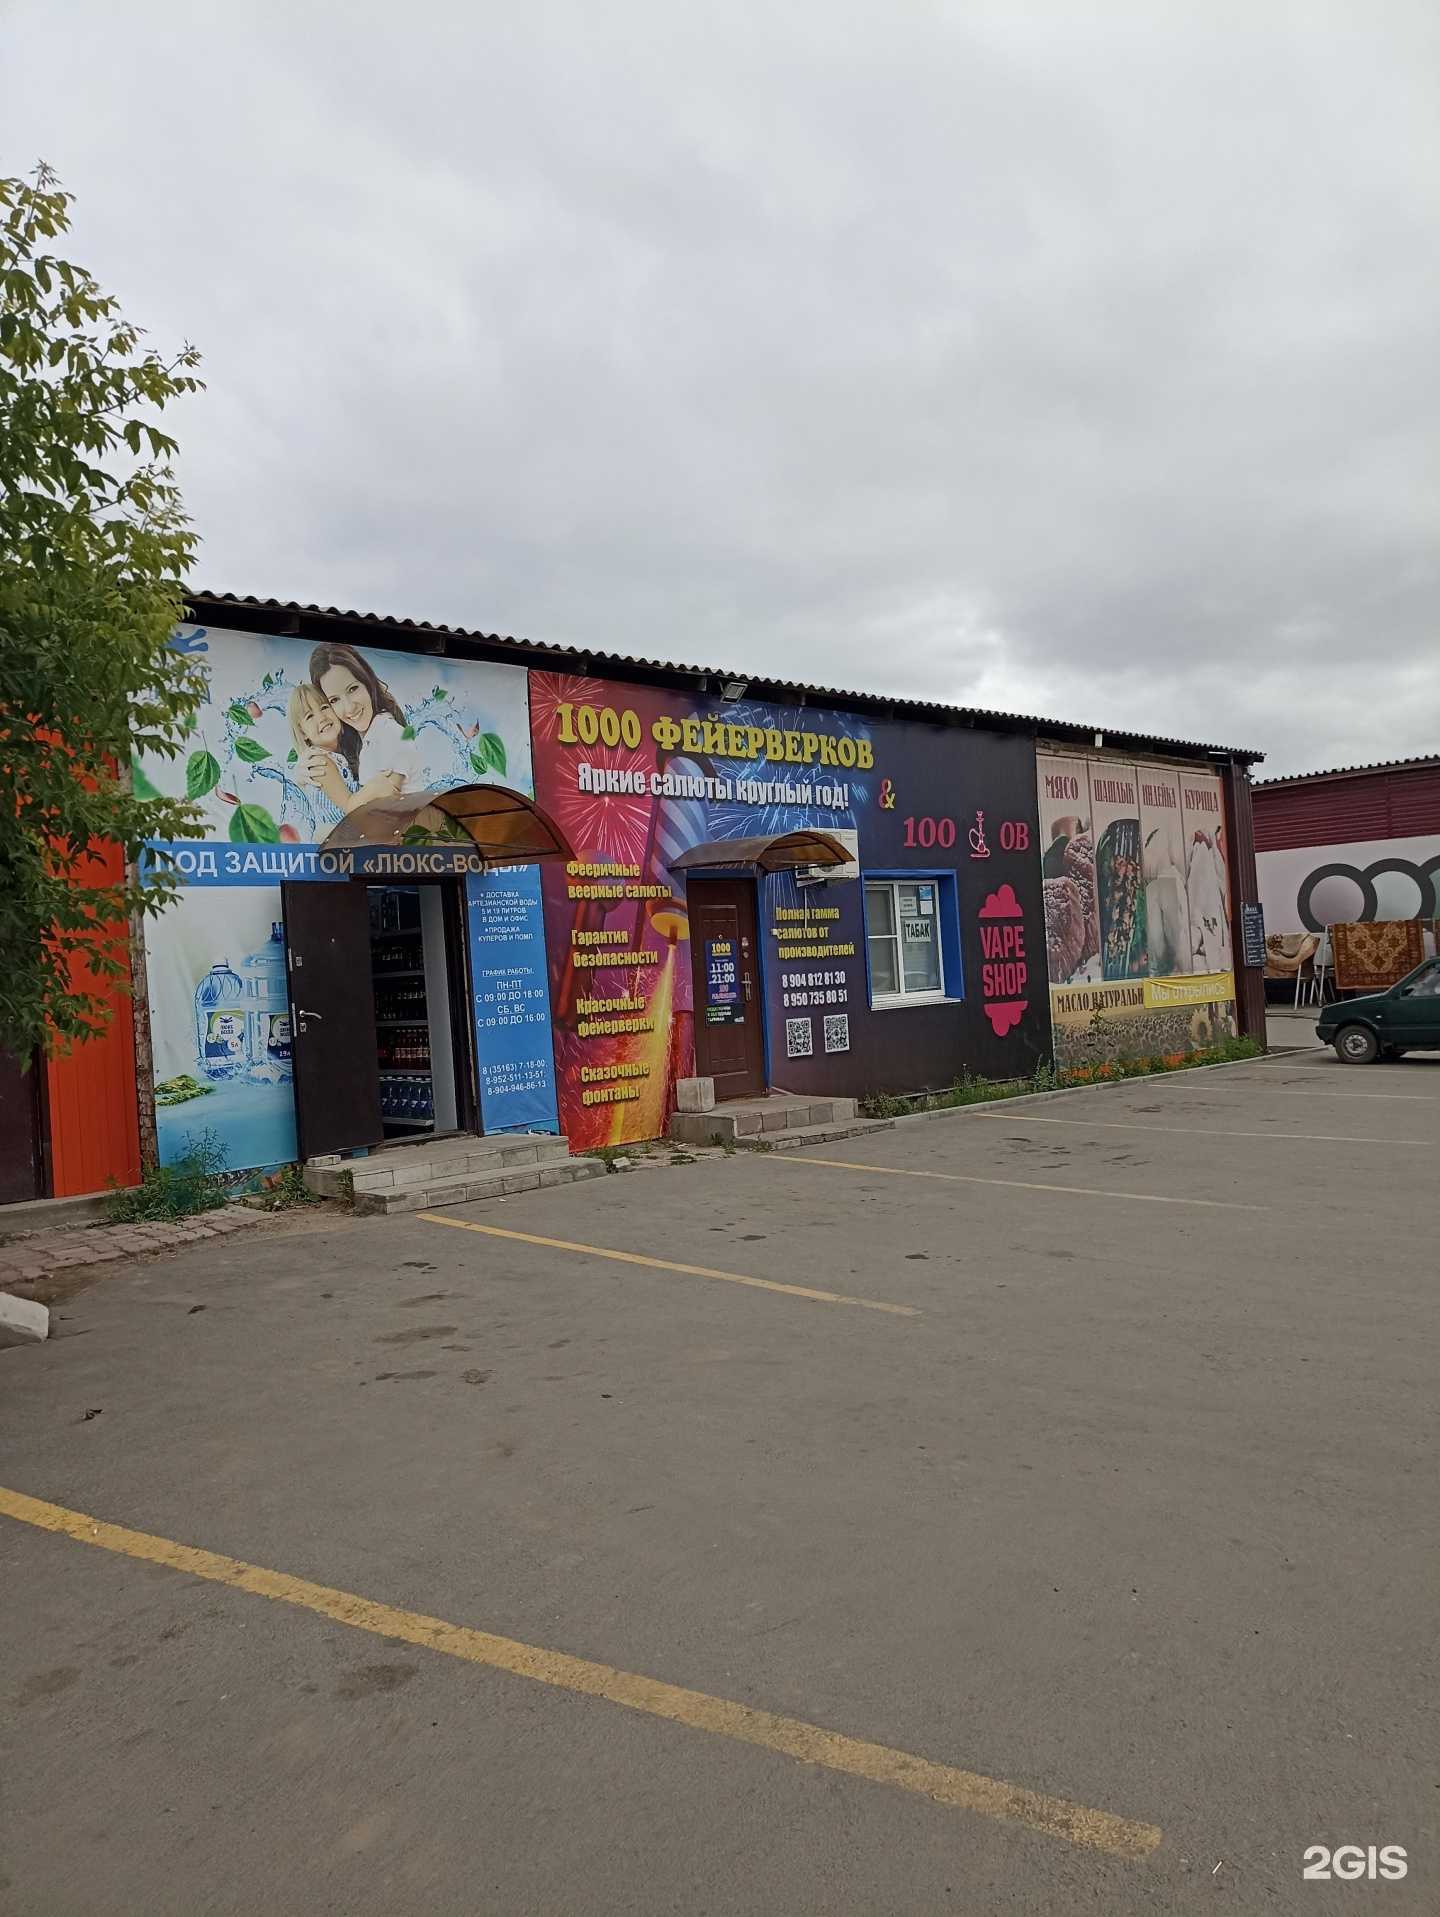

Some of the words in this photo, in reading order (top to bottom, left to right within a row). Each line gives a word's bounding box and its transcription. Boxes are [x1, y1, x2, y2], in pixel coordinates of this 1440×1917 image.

[556, 703, 642, 749] 1000
[651, 712, 875, 769] ФЕЙЕРВЕРКОВ
[577, 762, 646, 794] Яркие
[650, 771, 733, 800] салюты
[736, 778, 813, 805] круглый
[815, 783, 849, 810] год!
[878, 778, 896, 809] &
[1045, 775, 1079, 801] МЯСО
[1093, 778, 1135, 805] ШАШЛЫК
[1142, 783, 1177, 809] ИНДЕЙКА
[1184, 788, 1219, 813] КУРИЦА
[903, 816, 956, 848] 100
[1000, 821, 1029, 851] ОВ
[224, 847, 354, 877] ЗАЩИТОЙ
[566, 860, 641, 878] Фееричные
[486, 891, 520, 899] ДОСТАВКА
[567, 884, 624, 899] веерные
[625, 884, 673, 898] салюты
[520, 898, 538, 906] ВОДЫ
[775, 906, 811, 920] Полная
[811, 907, 840, 920] гамма
[489, 926, 520, 934] ПРОДАЖА
[571, 929, 629, 946] Гарантия
[777, 927, 818, 939] салютов
[819, 927, 829, 938] от
[905, 923, 930, 938] ТАБАК
[778, 941, 855, 959] производителей
[979, 925, 1026, 960] VAPE
[573, 950, 659, 968] безопасности
[711, 962, 735, 973] 11:00
[482, 969, 506, 977] ГРАФИК
[711, 973, 736, 984] 21:00
[781, 974, 788, 988] 8
[789, 973, 807, 988] 904
[807, 972, 823, 986] 812
[824, 971, 834, 985] 81
[834, 970, 846, 984] 30
[982, 961, 1028, 998] SHOP
[497, 980, 522, 990] ПН-ПТ
[476, 994, 482, 1002] С
[508, 991, 521, 1000] ДО
[783, 993, 790, 1007] 8
[790, 992, 808, 1007] 950
[808, 991, 825, 1005] 735
[826, 990, 837, 1004] 80
[838, 989, 848, 1002] 51
[1057, 993, 1090, 1013] МАСЛО
[514, 1003, 526, 1012] ВС
[576, 997, 646, 1015] Красочные
[477, 1018, 484, 1027] С
[510, 1015, 523, 1024] ДО
[577, 1017, 655, 1038] фейерверки
[482, 1066, 488, 1075] 8
[581, 1062, 650, 1082] Сказочные
[582, 1085, 641, 1106] фонтаны
